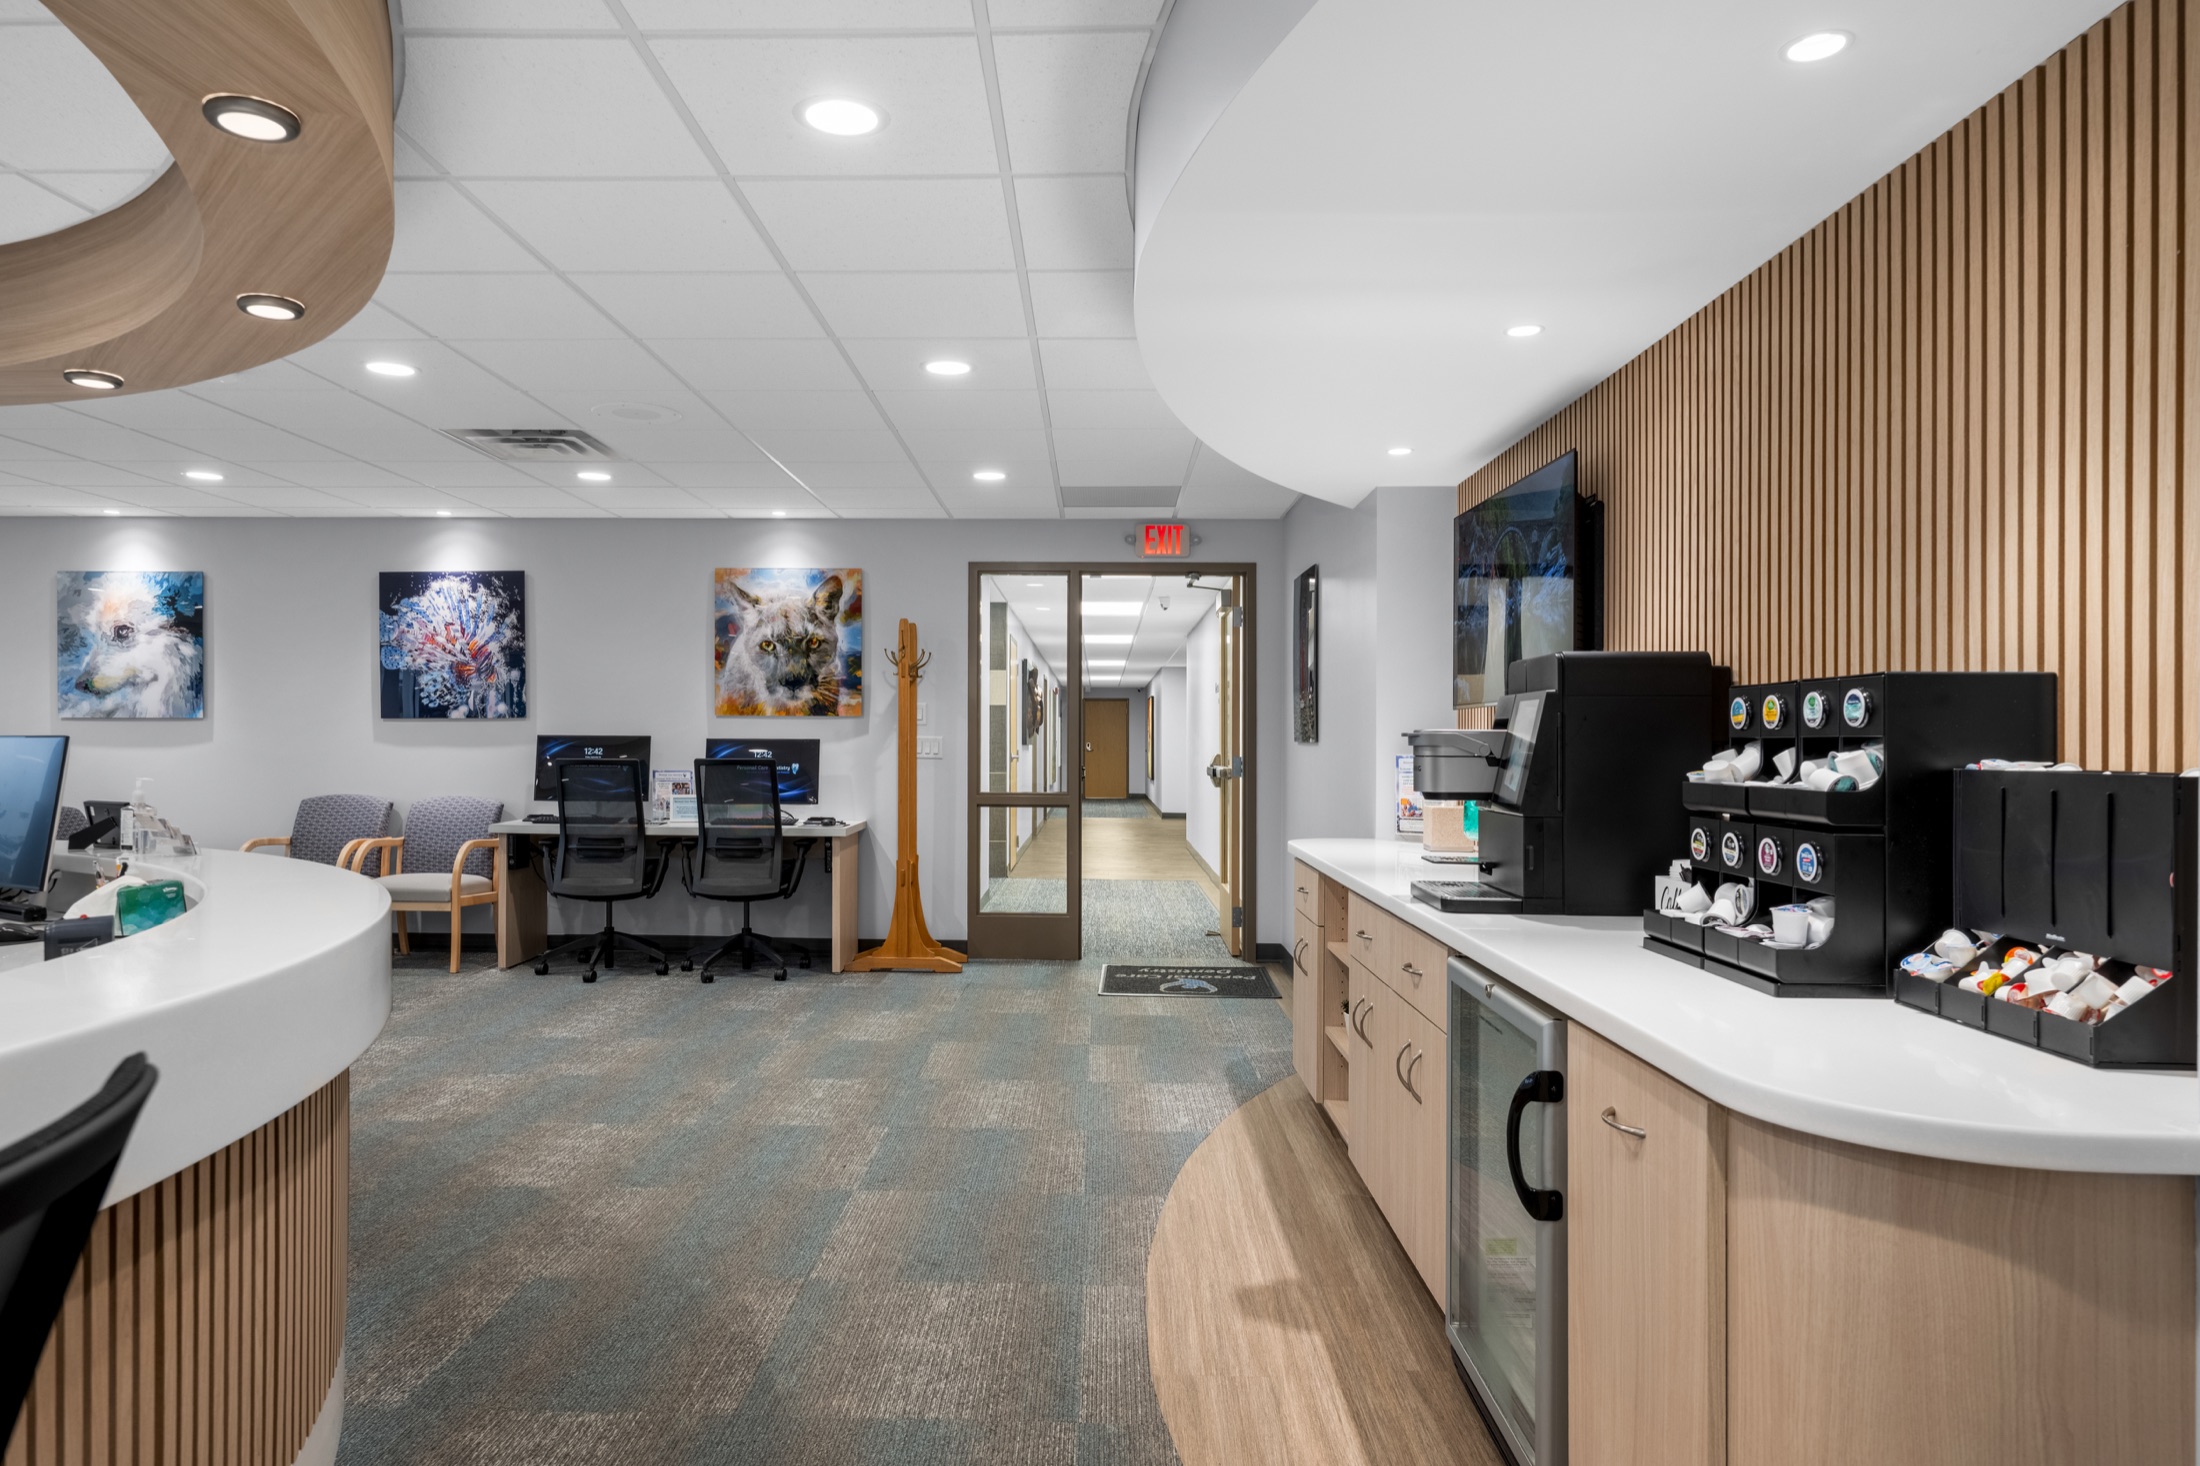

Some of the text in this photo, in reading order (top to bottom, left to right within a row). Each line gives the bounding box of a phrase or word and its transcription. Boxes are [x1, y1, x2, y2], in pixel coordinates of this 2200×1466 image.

[1145, 525, 1184, 555] EXIT
[584, 747, 603, 755] 12:42
[754, 750, 773, 758] 12:42
